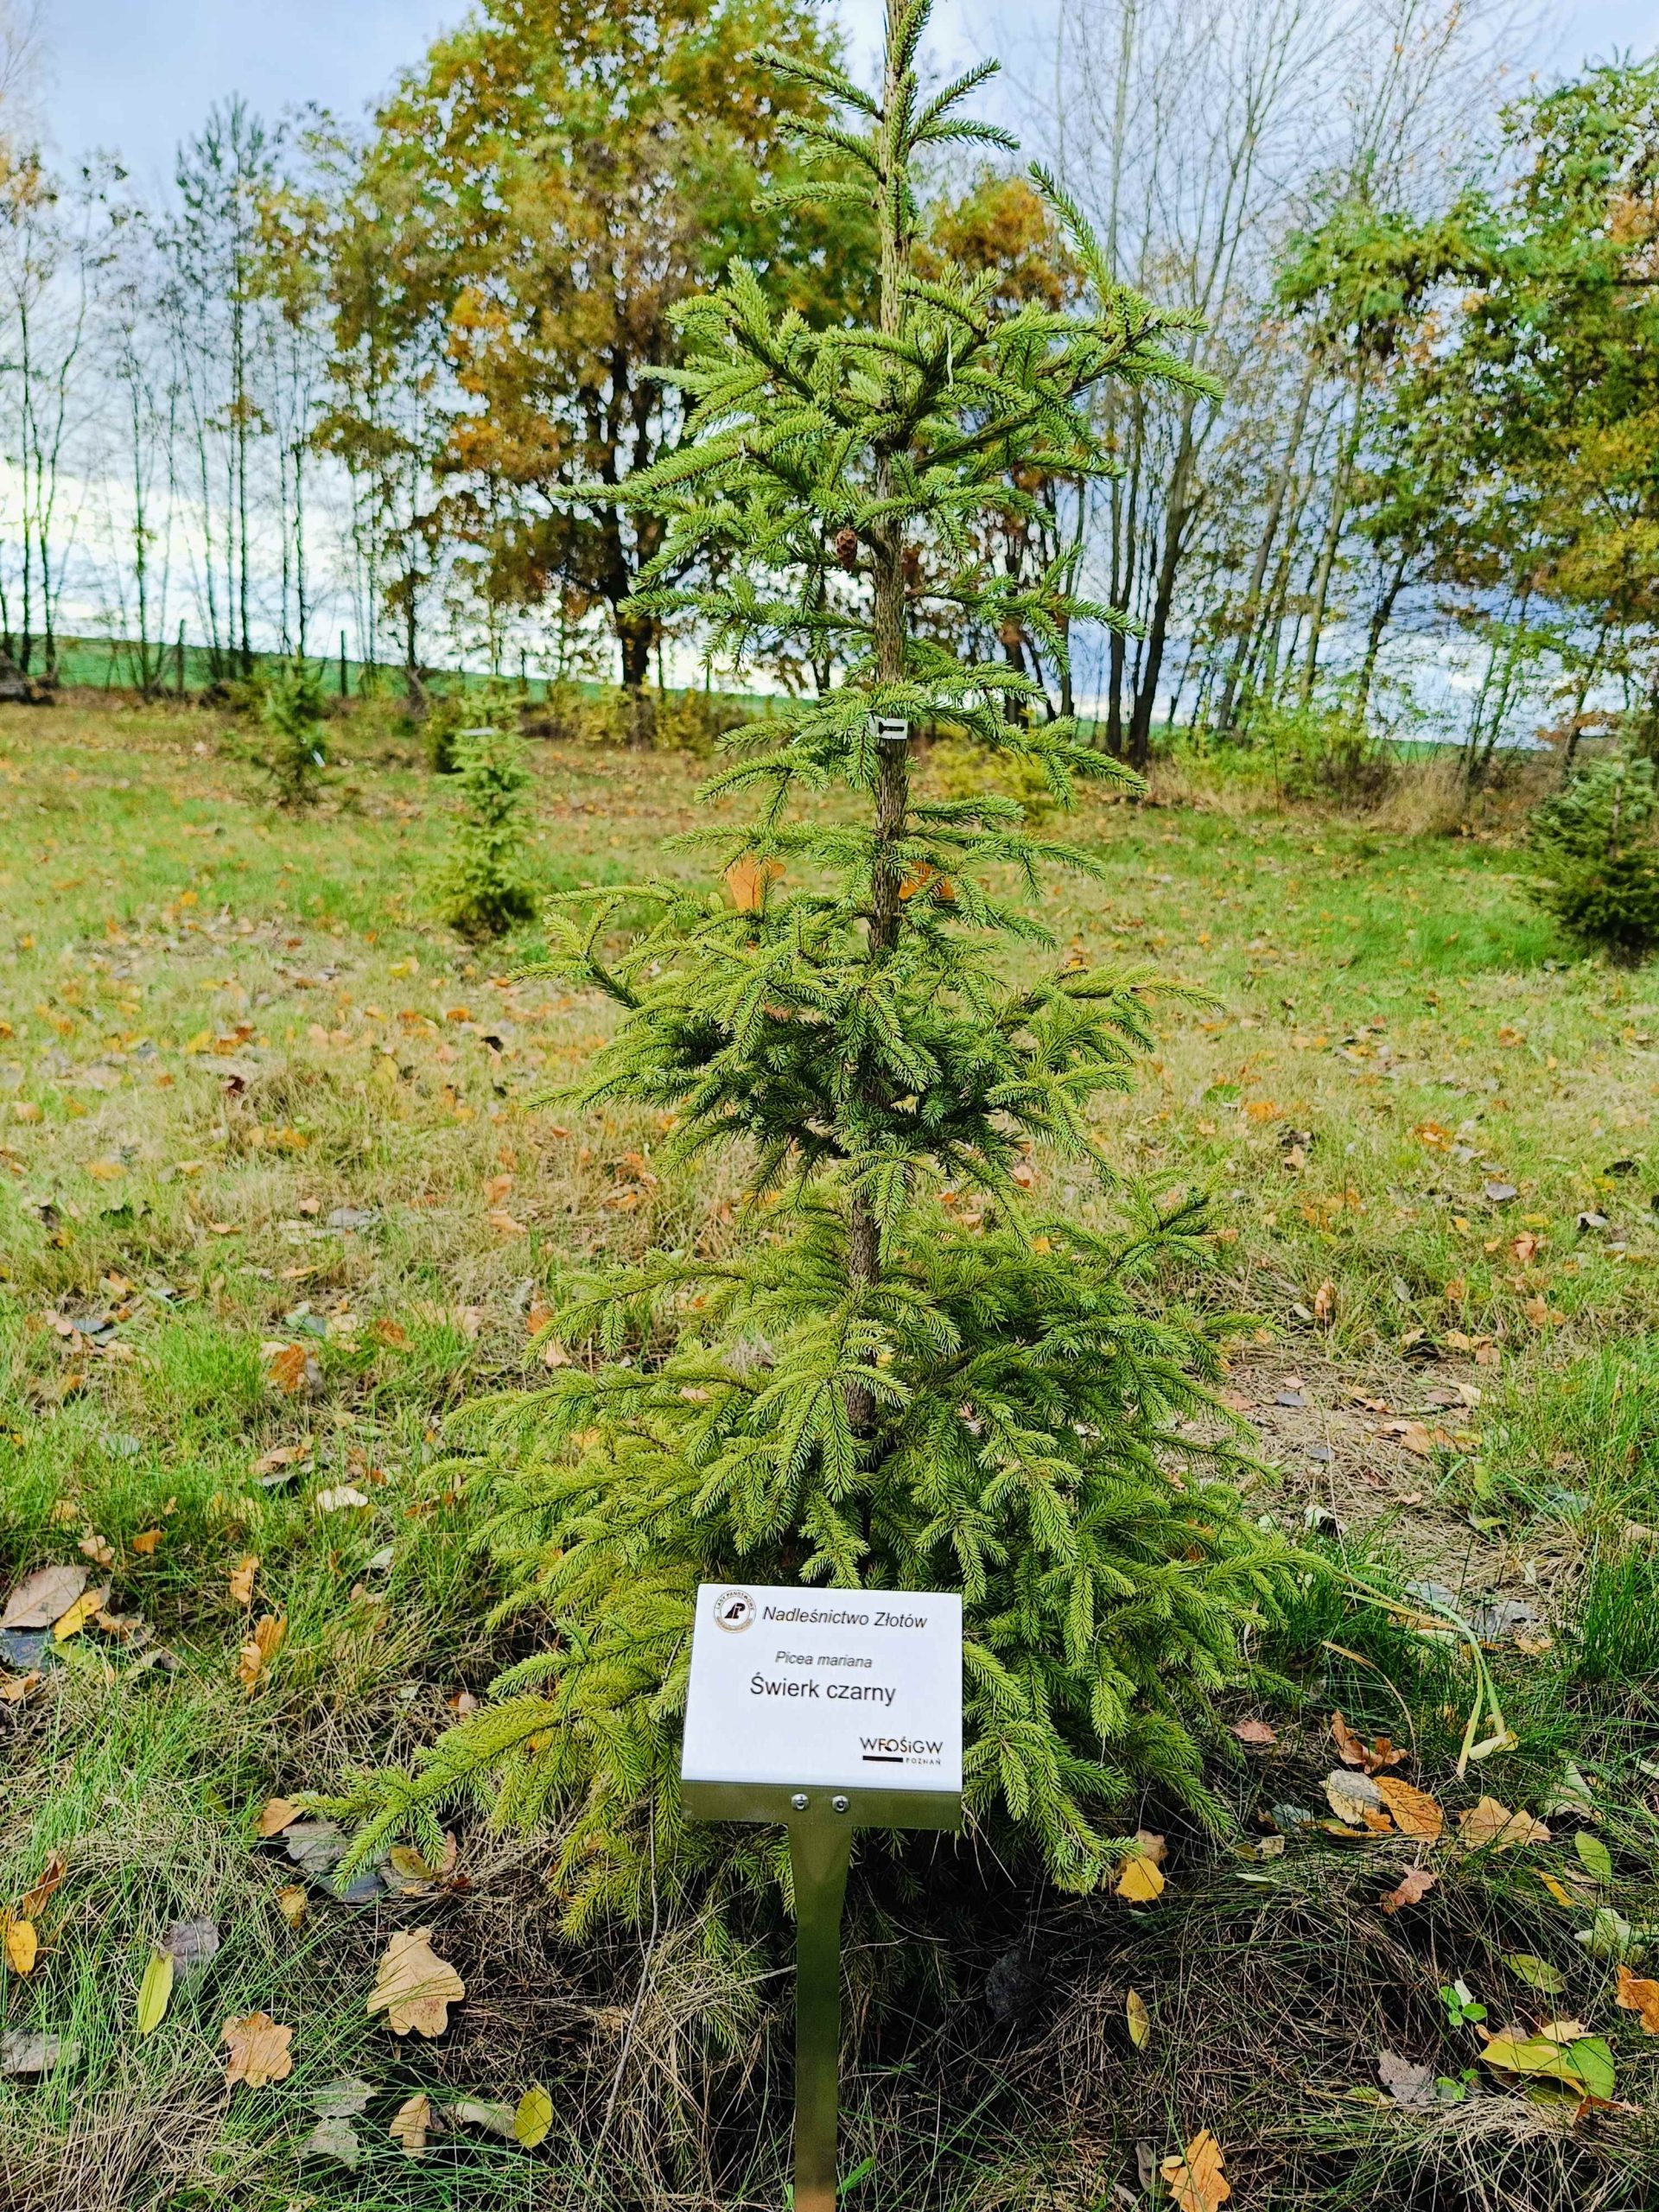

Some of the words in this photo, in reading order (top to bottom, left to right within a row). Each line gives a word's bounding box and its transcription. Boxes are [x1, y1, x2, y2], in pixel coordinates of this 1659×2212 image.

[762, 1605, 869, 1626] Nadleśnictwo
[874, 1611, 928, 1629] Złotów
[775, 1650, 814, 1665] Picea
[817, 1655, 873, 1669] mariana
[750, 1671, 820, 1698] Świerk
[826, 1684, 896, 1707] czarny
[860, 1736, 944, 1754] WFOŚiGW
